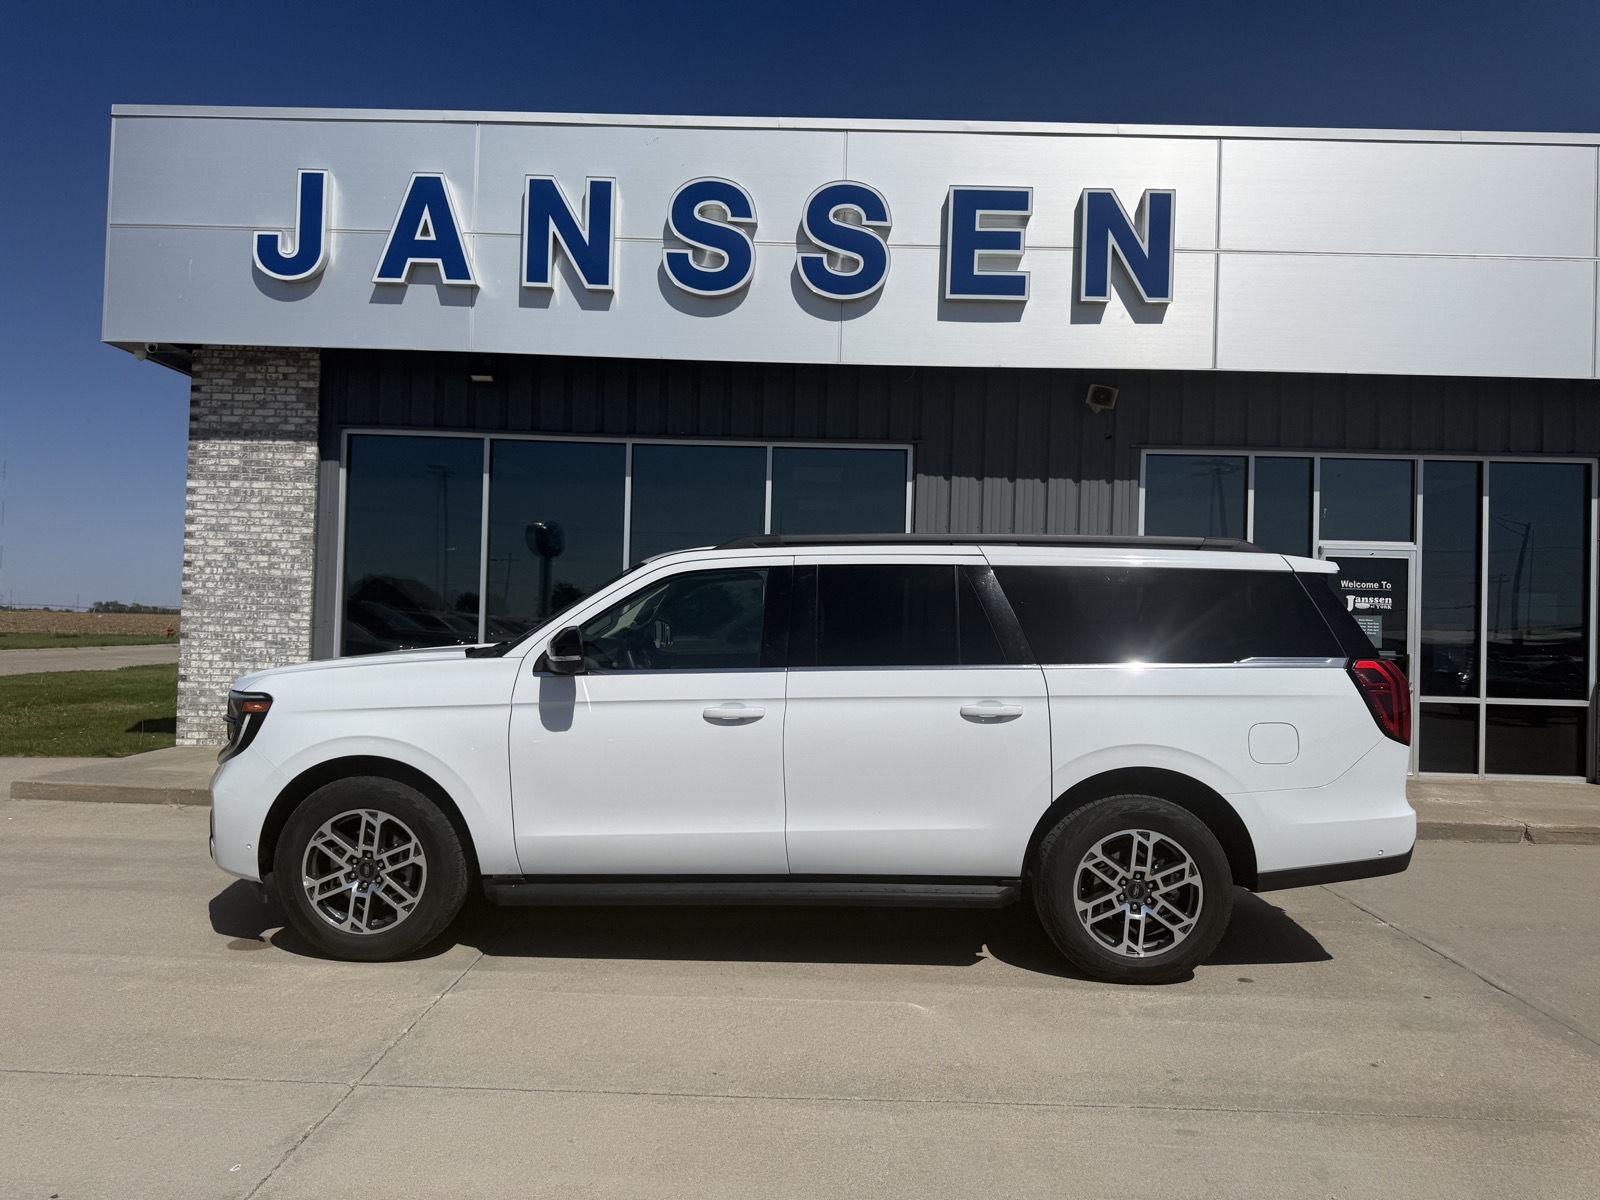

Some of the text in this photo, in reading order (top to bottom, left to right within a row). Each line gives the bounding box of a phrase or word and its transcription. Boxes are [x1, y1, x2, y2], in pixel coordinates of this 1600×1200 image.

[252, 168, 1176, 304] JANSSEN
[1340, 580, 1392, 589] Welcome To
[1346, 595, 1392, 612] Janssen
